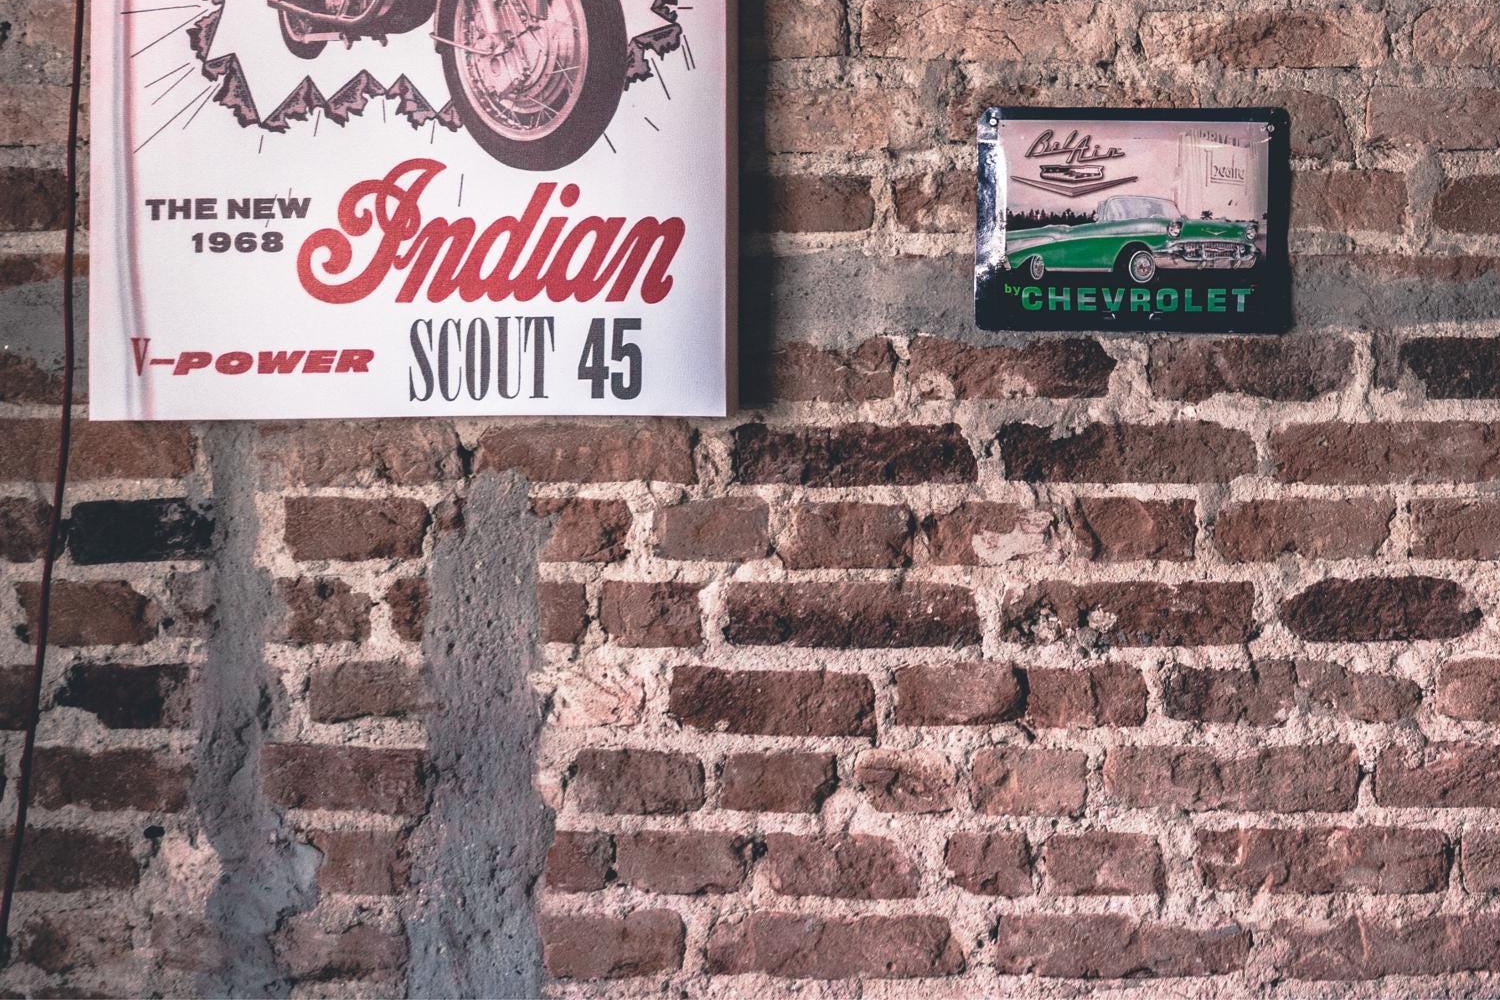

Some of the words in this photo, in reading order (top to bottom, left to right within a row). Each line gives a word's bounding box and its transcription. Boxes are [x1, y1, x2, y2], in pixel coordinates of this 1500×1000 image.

[1024, 129, 1078, 158] Bel
[1066, 133, 1126, 164] Air
[145, 198, 218, 221] THE
[227, 197, 311, 220] NEW
[191, 231, 285, 254] 1968
[296, 158, 686, 305] Indian
[1004, 284, 1021, 296] by
[1021, 286, 1251, 313] CHEVROLET
[130, 337, 374, 377] V-POWER
[409, 316, 555, 402] SCOUT
[577, 317, 642, 400] 45
